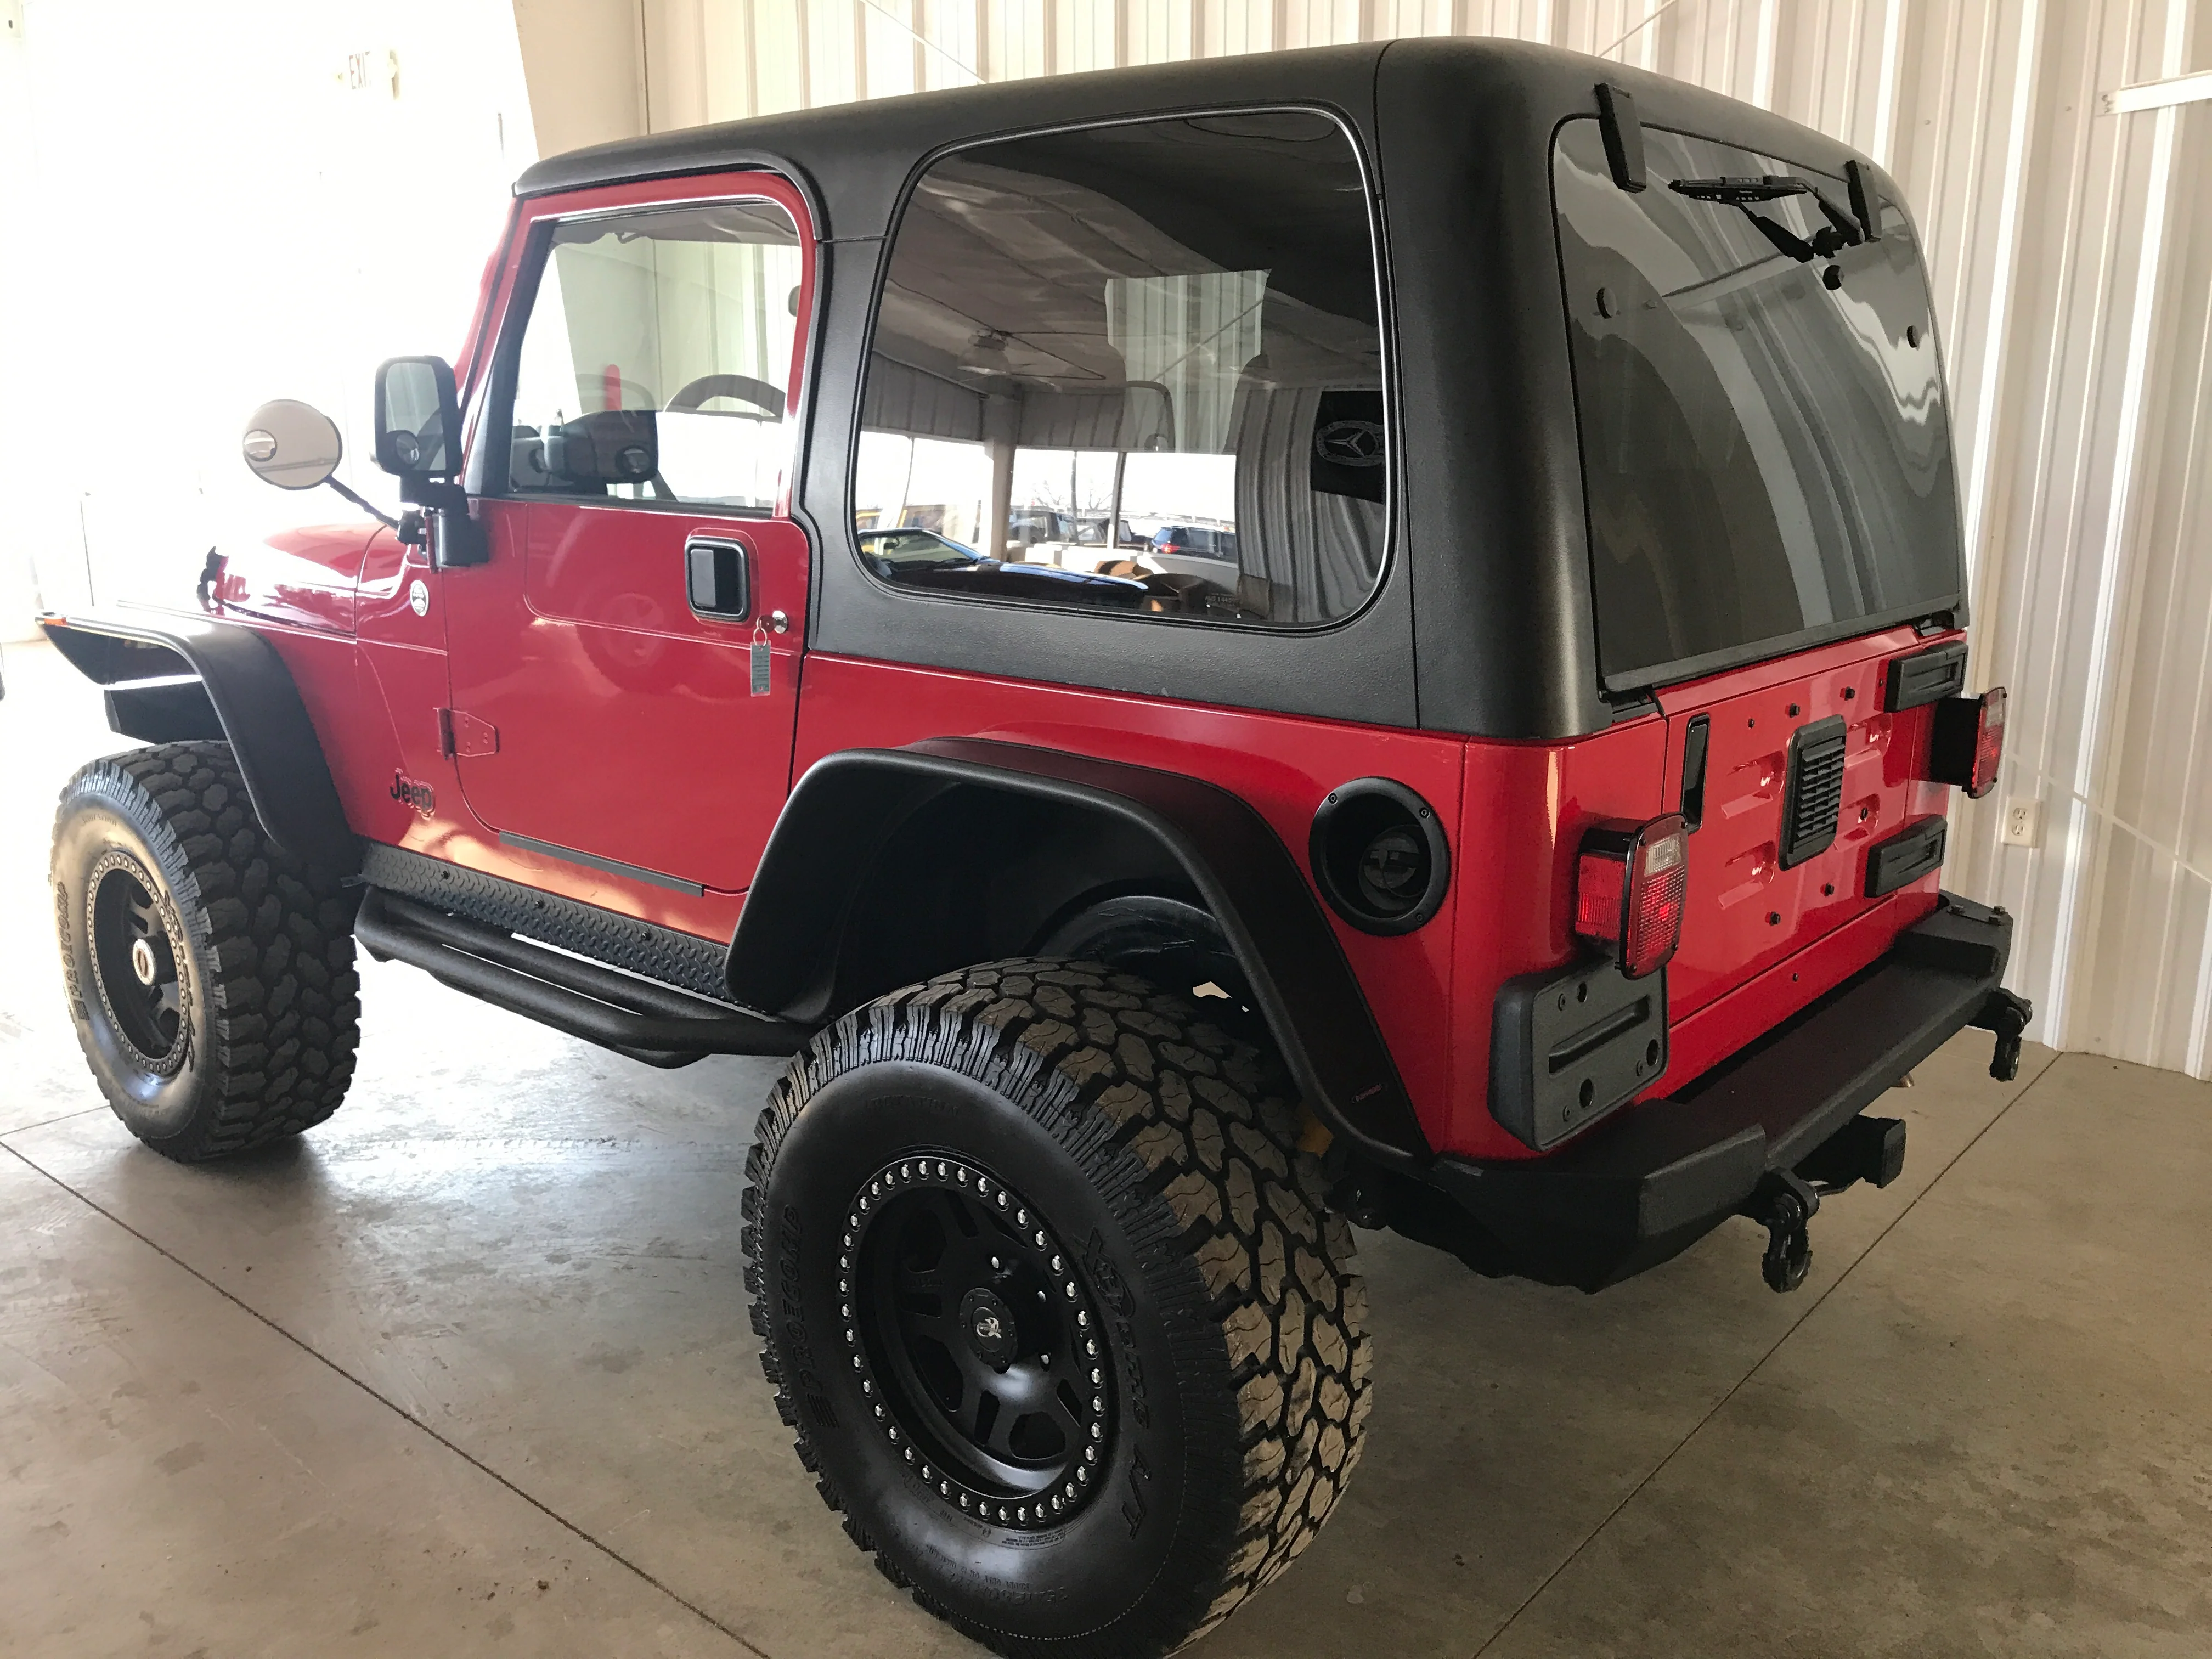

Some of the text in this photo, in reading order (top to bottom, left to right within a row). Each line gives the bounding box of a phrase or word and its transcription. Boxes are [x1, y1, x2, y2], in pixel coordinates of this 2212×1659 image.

[390, 774, 433, 813] Jeep
[57, 881, 83, 999] PRO COMP
[780, 1204, 823, 1393] PRO COMP
